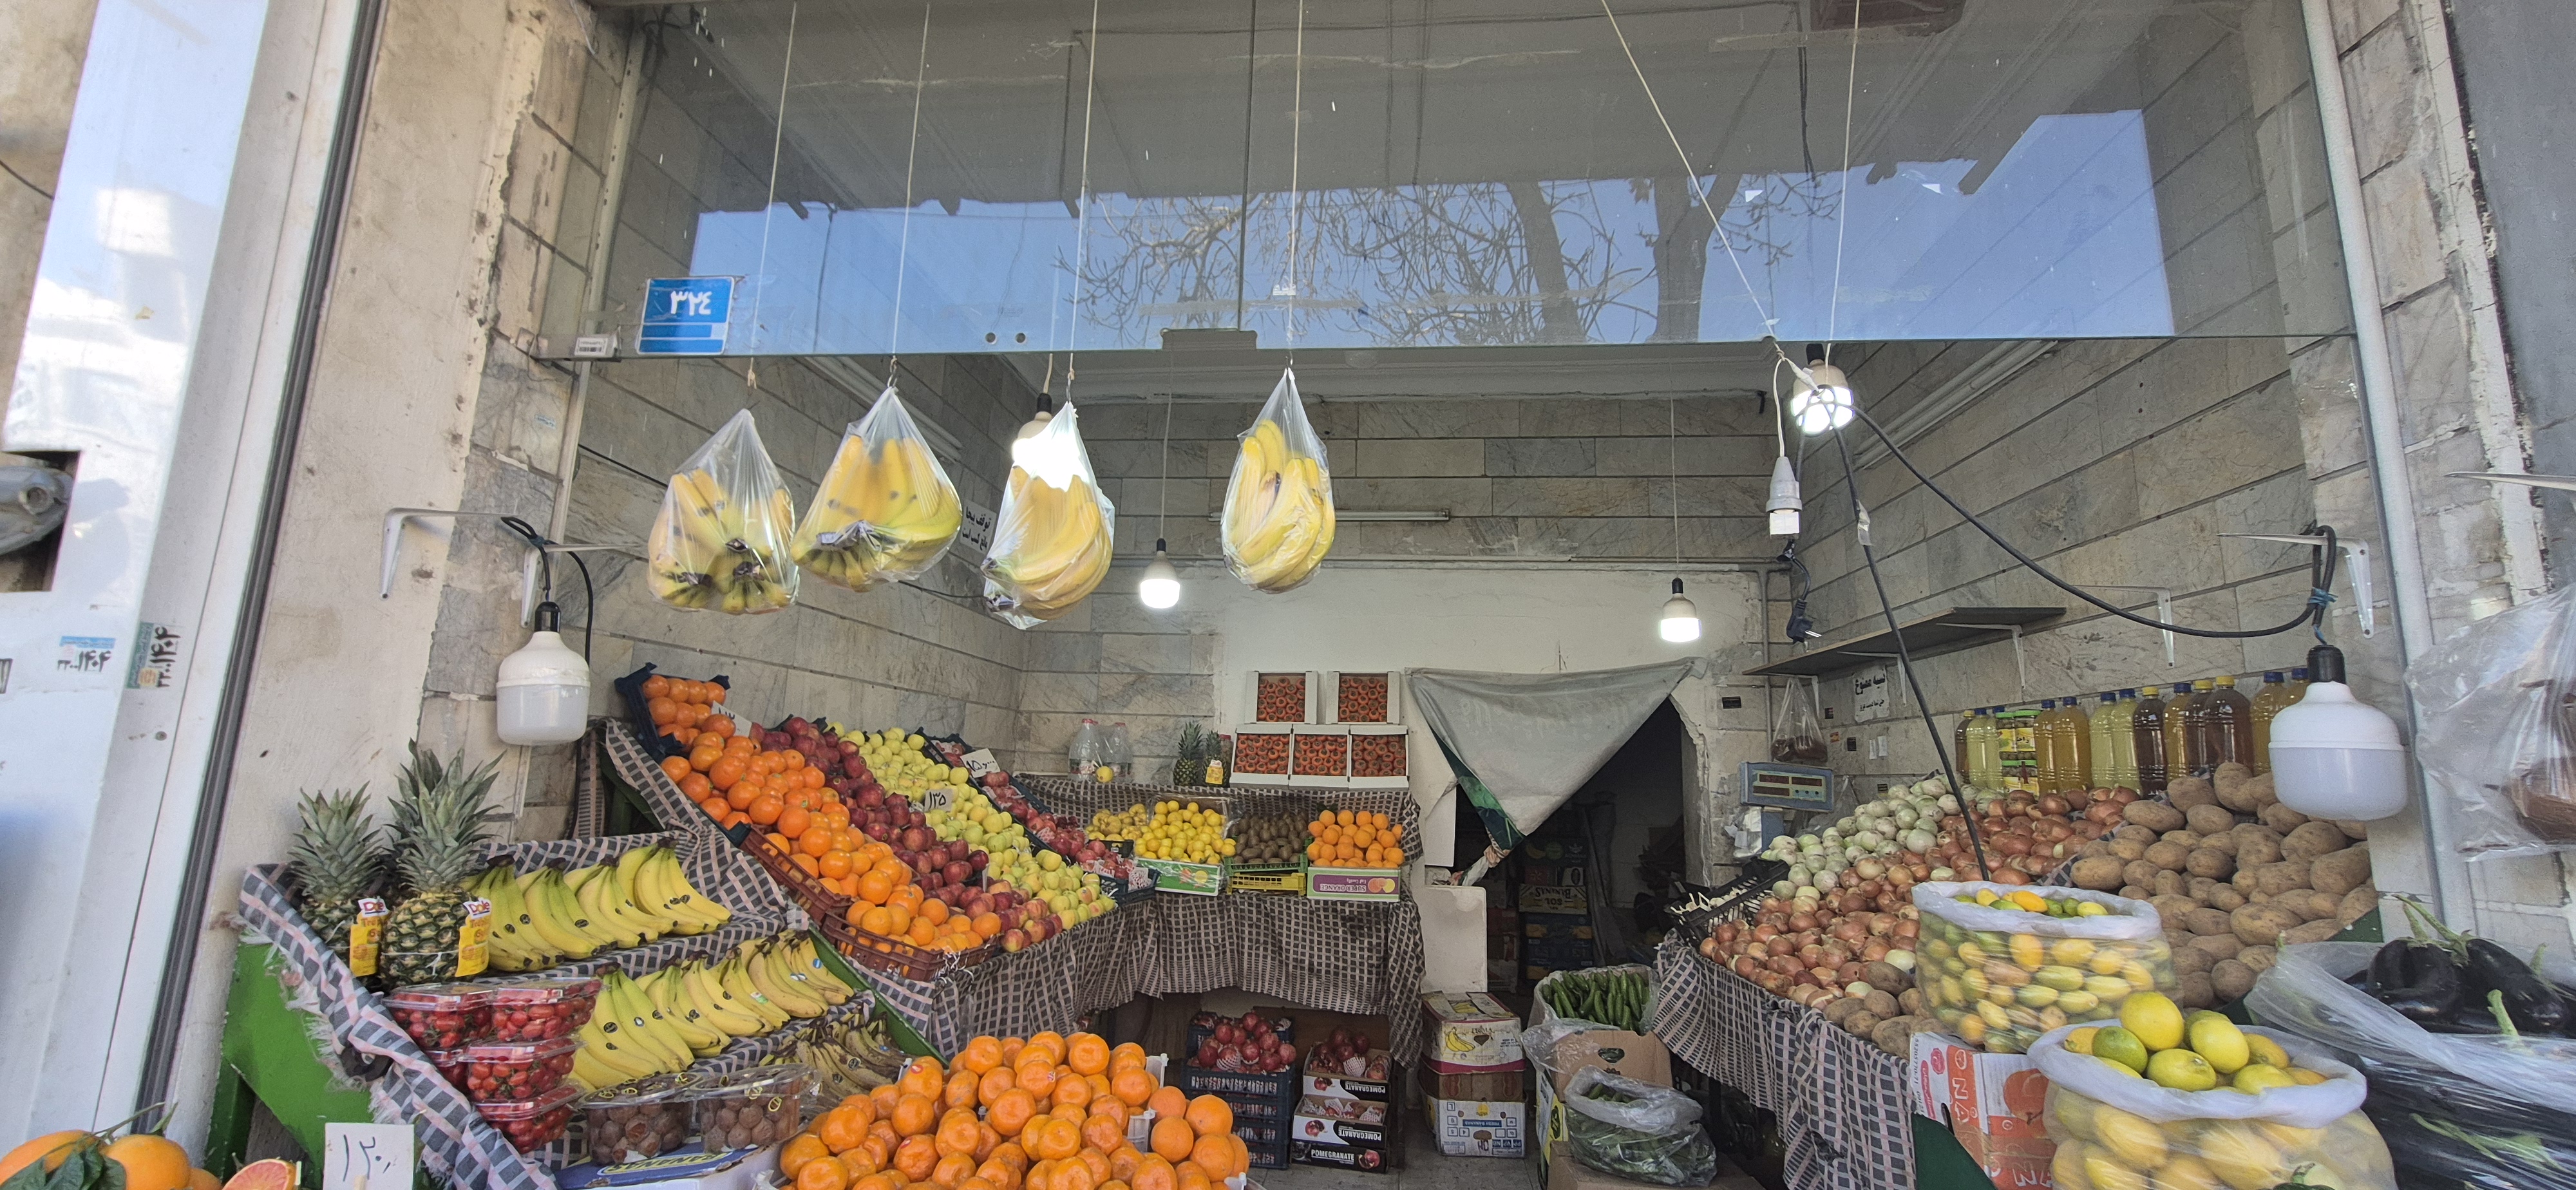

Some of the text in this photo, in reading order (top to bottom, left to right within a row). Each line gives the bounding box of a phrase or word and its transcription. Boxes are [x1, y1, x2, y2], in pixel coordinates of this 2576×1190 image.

[1320, 883, 1367, 892] SUPER ORANGE
[468, 900, 491, 913] Dole
[1345, 1083, 1385, 1093] POMEGRANATE
[1338, 1129, 1382, 1141] POMEGRANATE
[1311, 1149, 1354, 1161] POMEGRANATE
